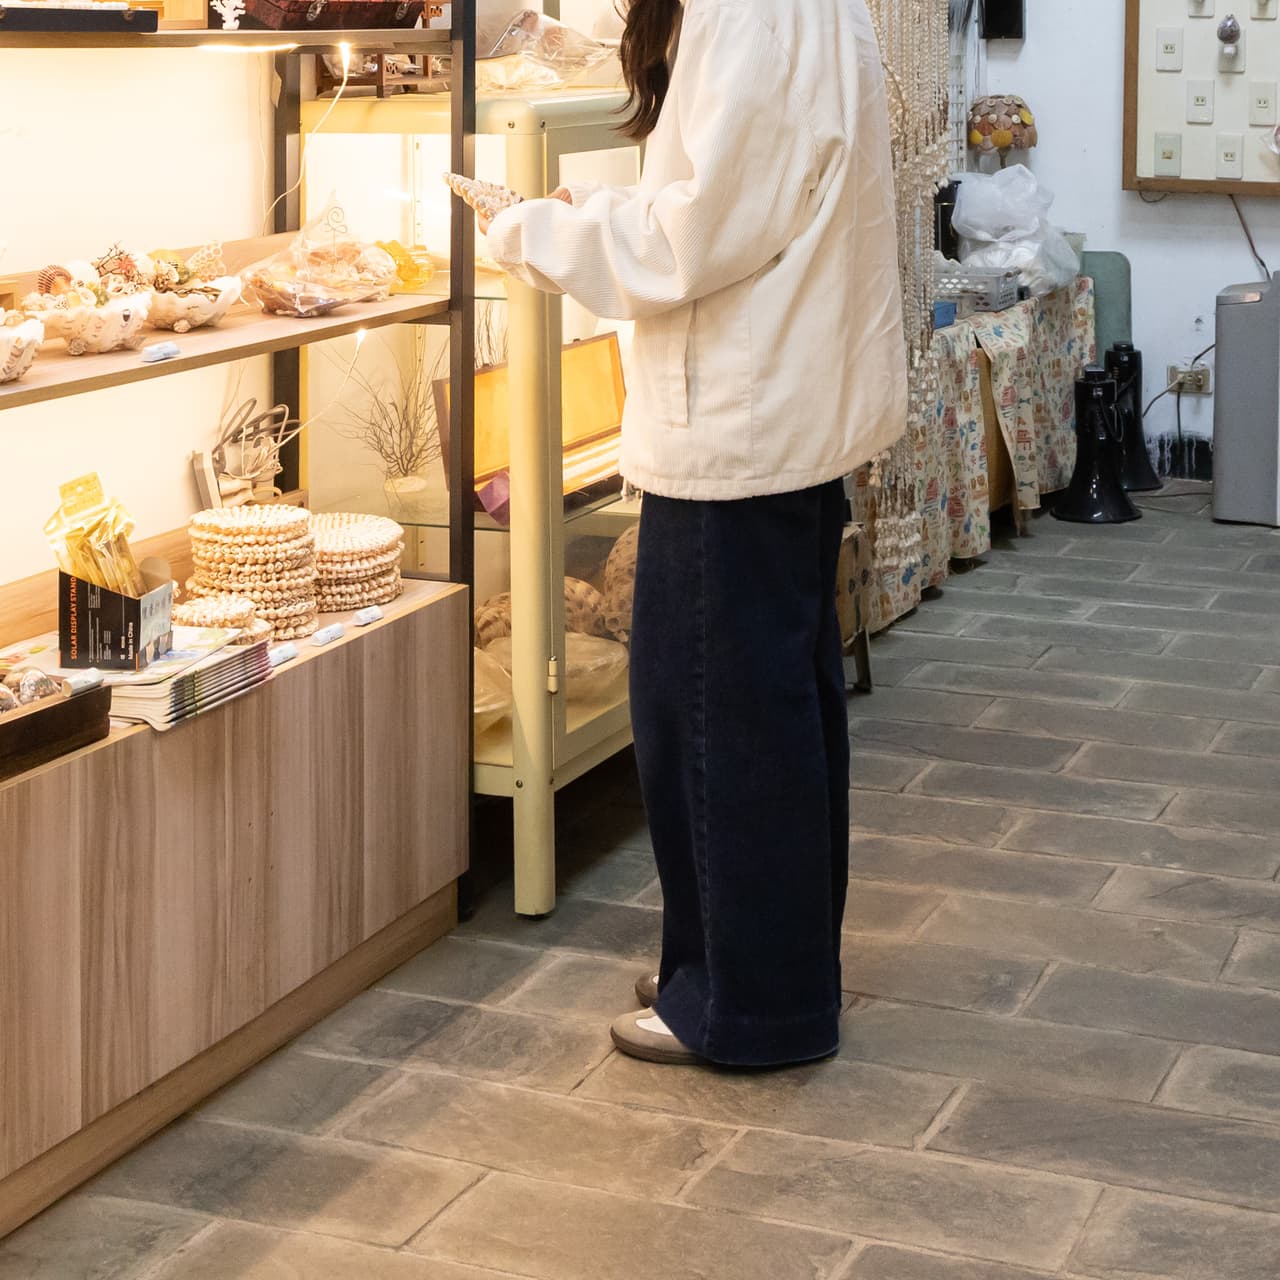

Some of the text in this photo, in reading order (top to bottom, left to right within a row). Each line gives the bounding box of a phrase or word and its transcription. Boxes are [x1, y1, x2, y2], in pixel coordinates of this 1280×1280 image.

[70, 576, 78, 660] SOLAR DISPLAY STAND
